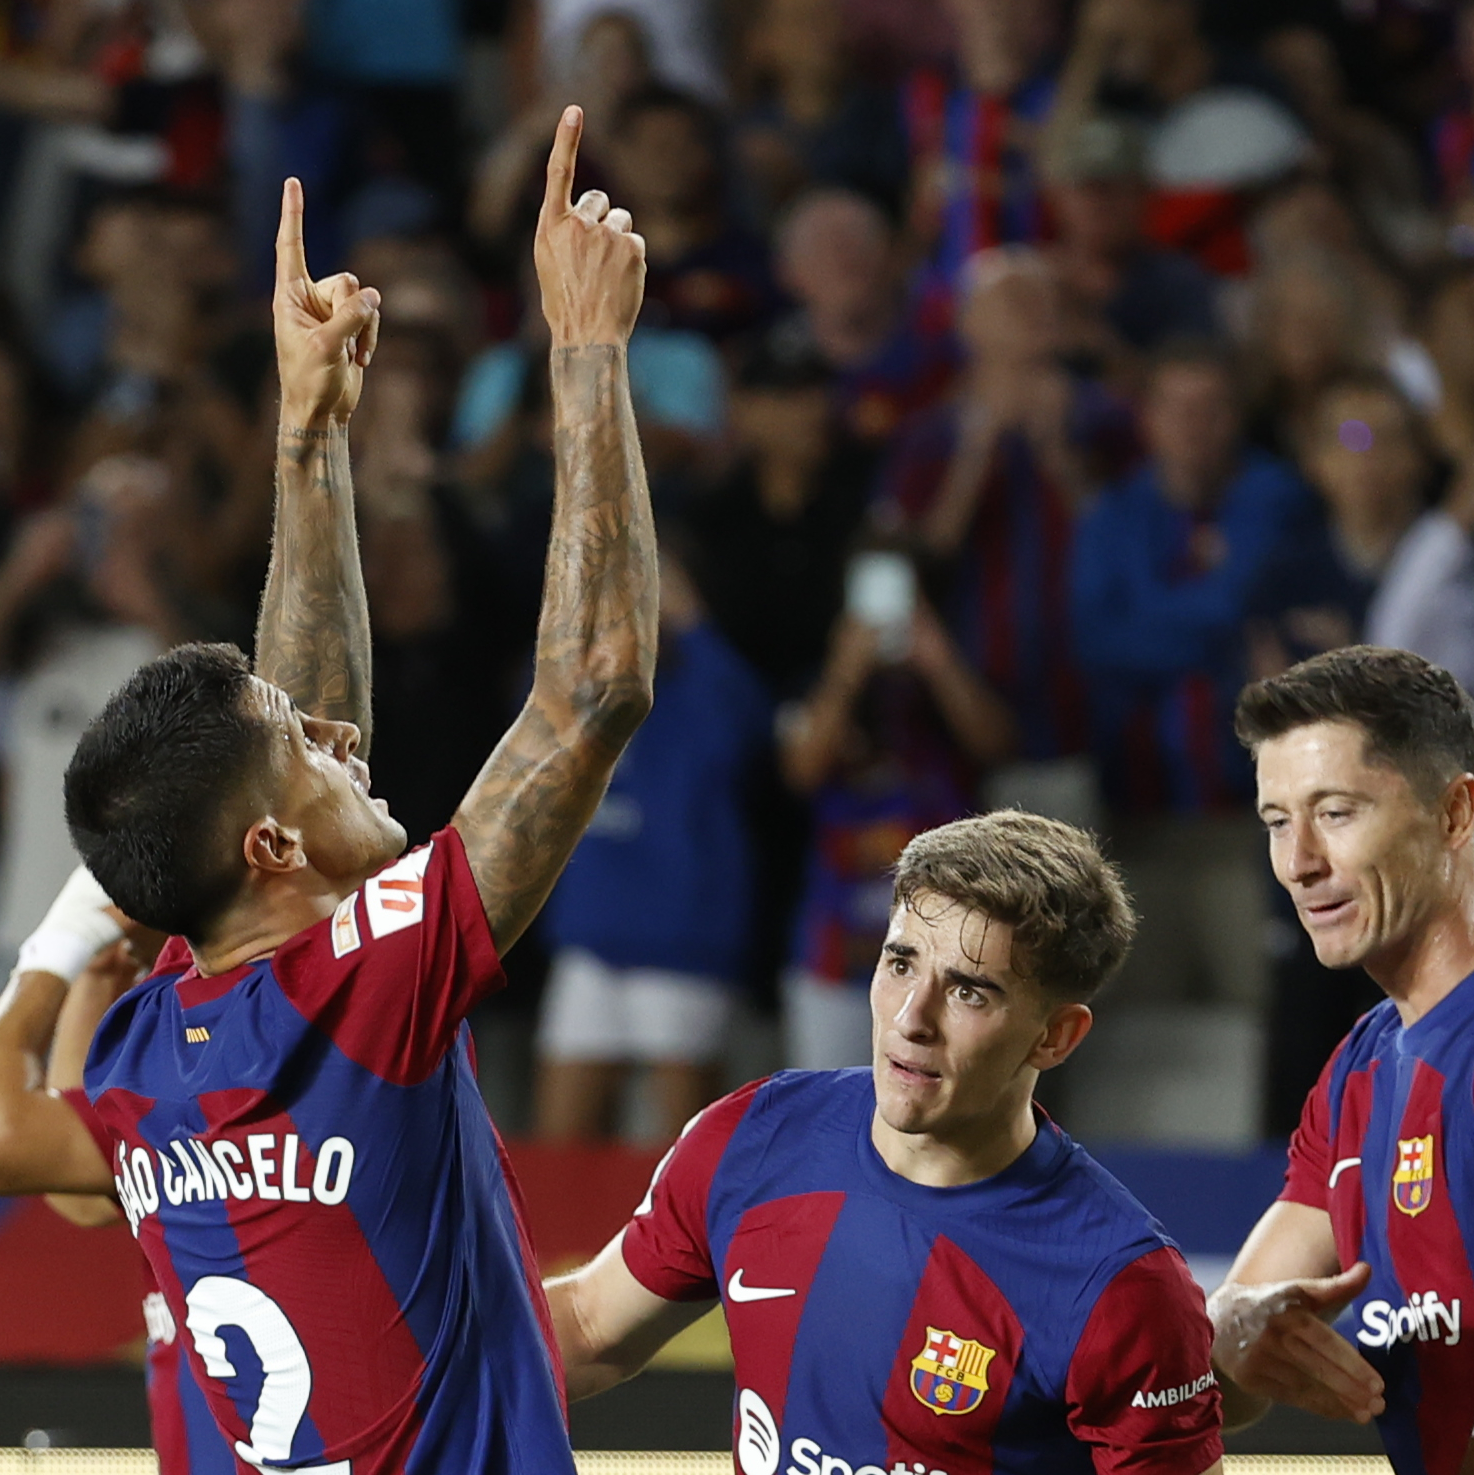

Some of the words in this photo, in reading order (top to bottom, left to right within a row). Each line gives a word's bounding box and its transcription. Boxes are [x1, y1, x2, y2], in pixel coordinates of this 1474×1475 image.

[156, 1133, 355, 1206] CANCELO
[1356, 1290, 1461, 1356] Spotify
[936, 1364, 965, 1382] FCB
[1131, 1369, 1219, 1408] AMBILIGH
